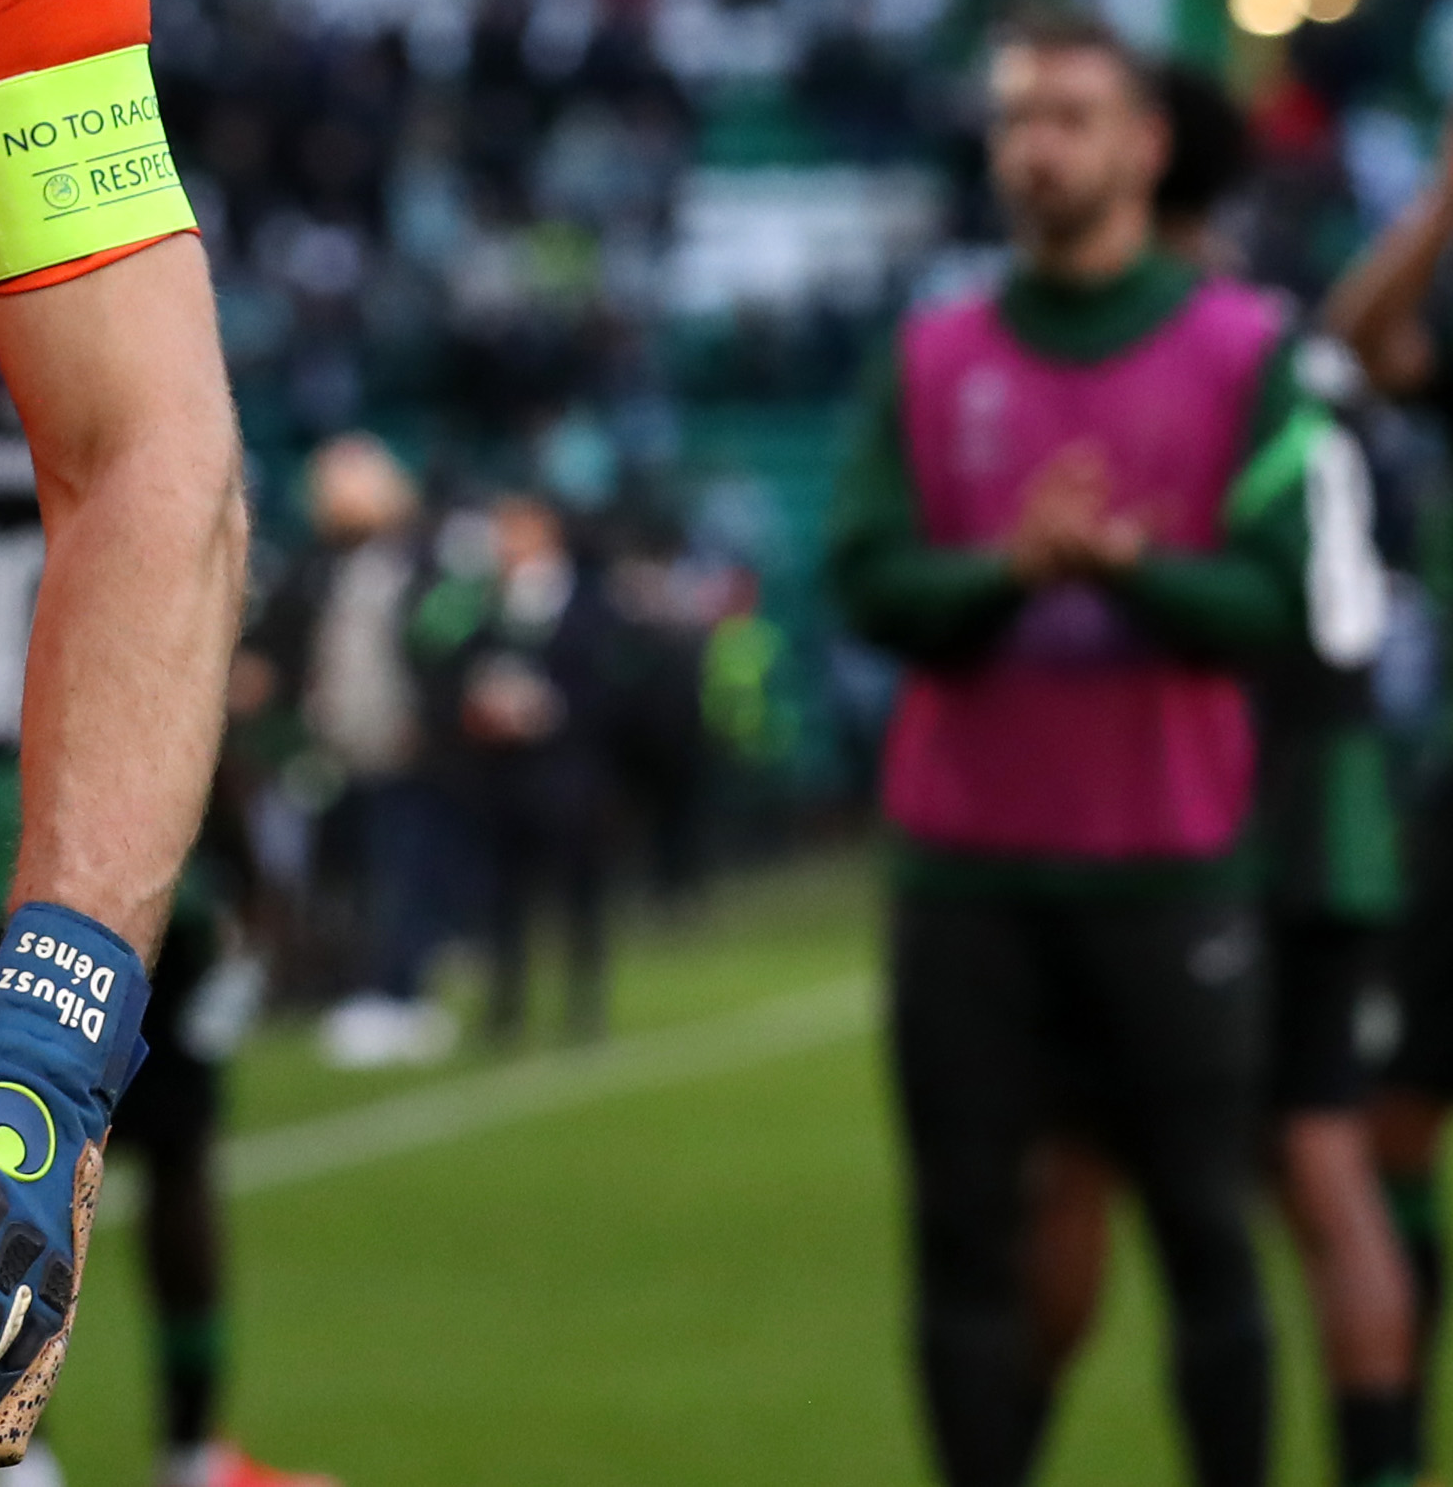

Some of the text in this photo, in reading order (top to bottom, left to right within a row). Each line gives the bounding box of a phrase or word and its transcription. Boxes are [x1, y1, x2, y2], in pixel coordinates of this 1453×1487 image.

[3, 122, 57, 156] NO
[61, 109, 105, 140] TO
[15, 932, 115, 1004] Dénes
